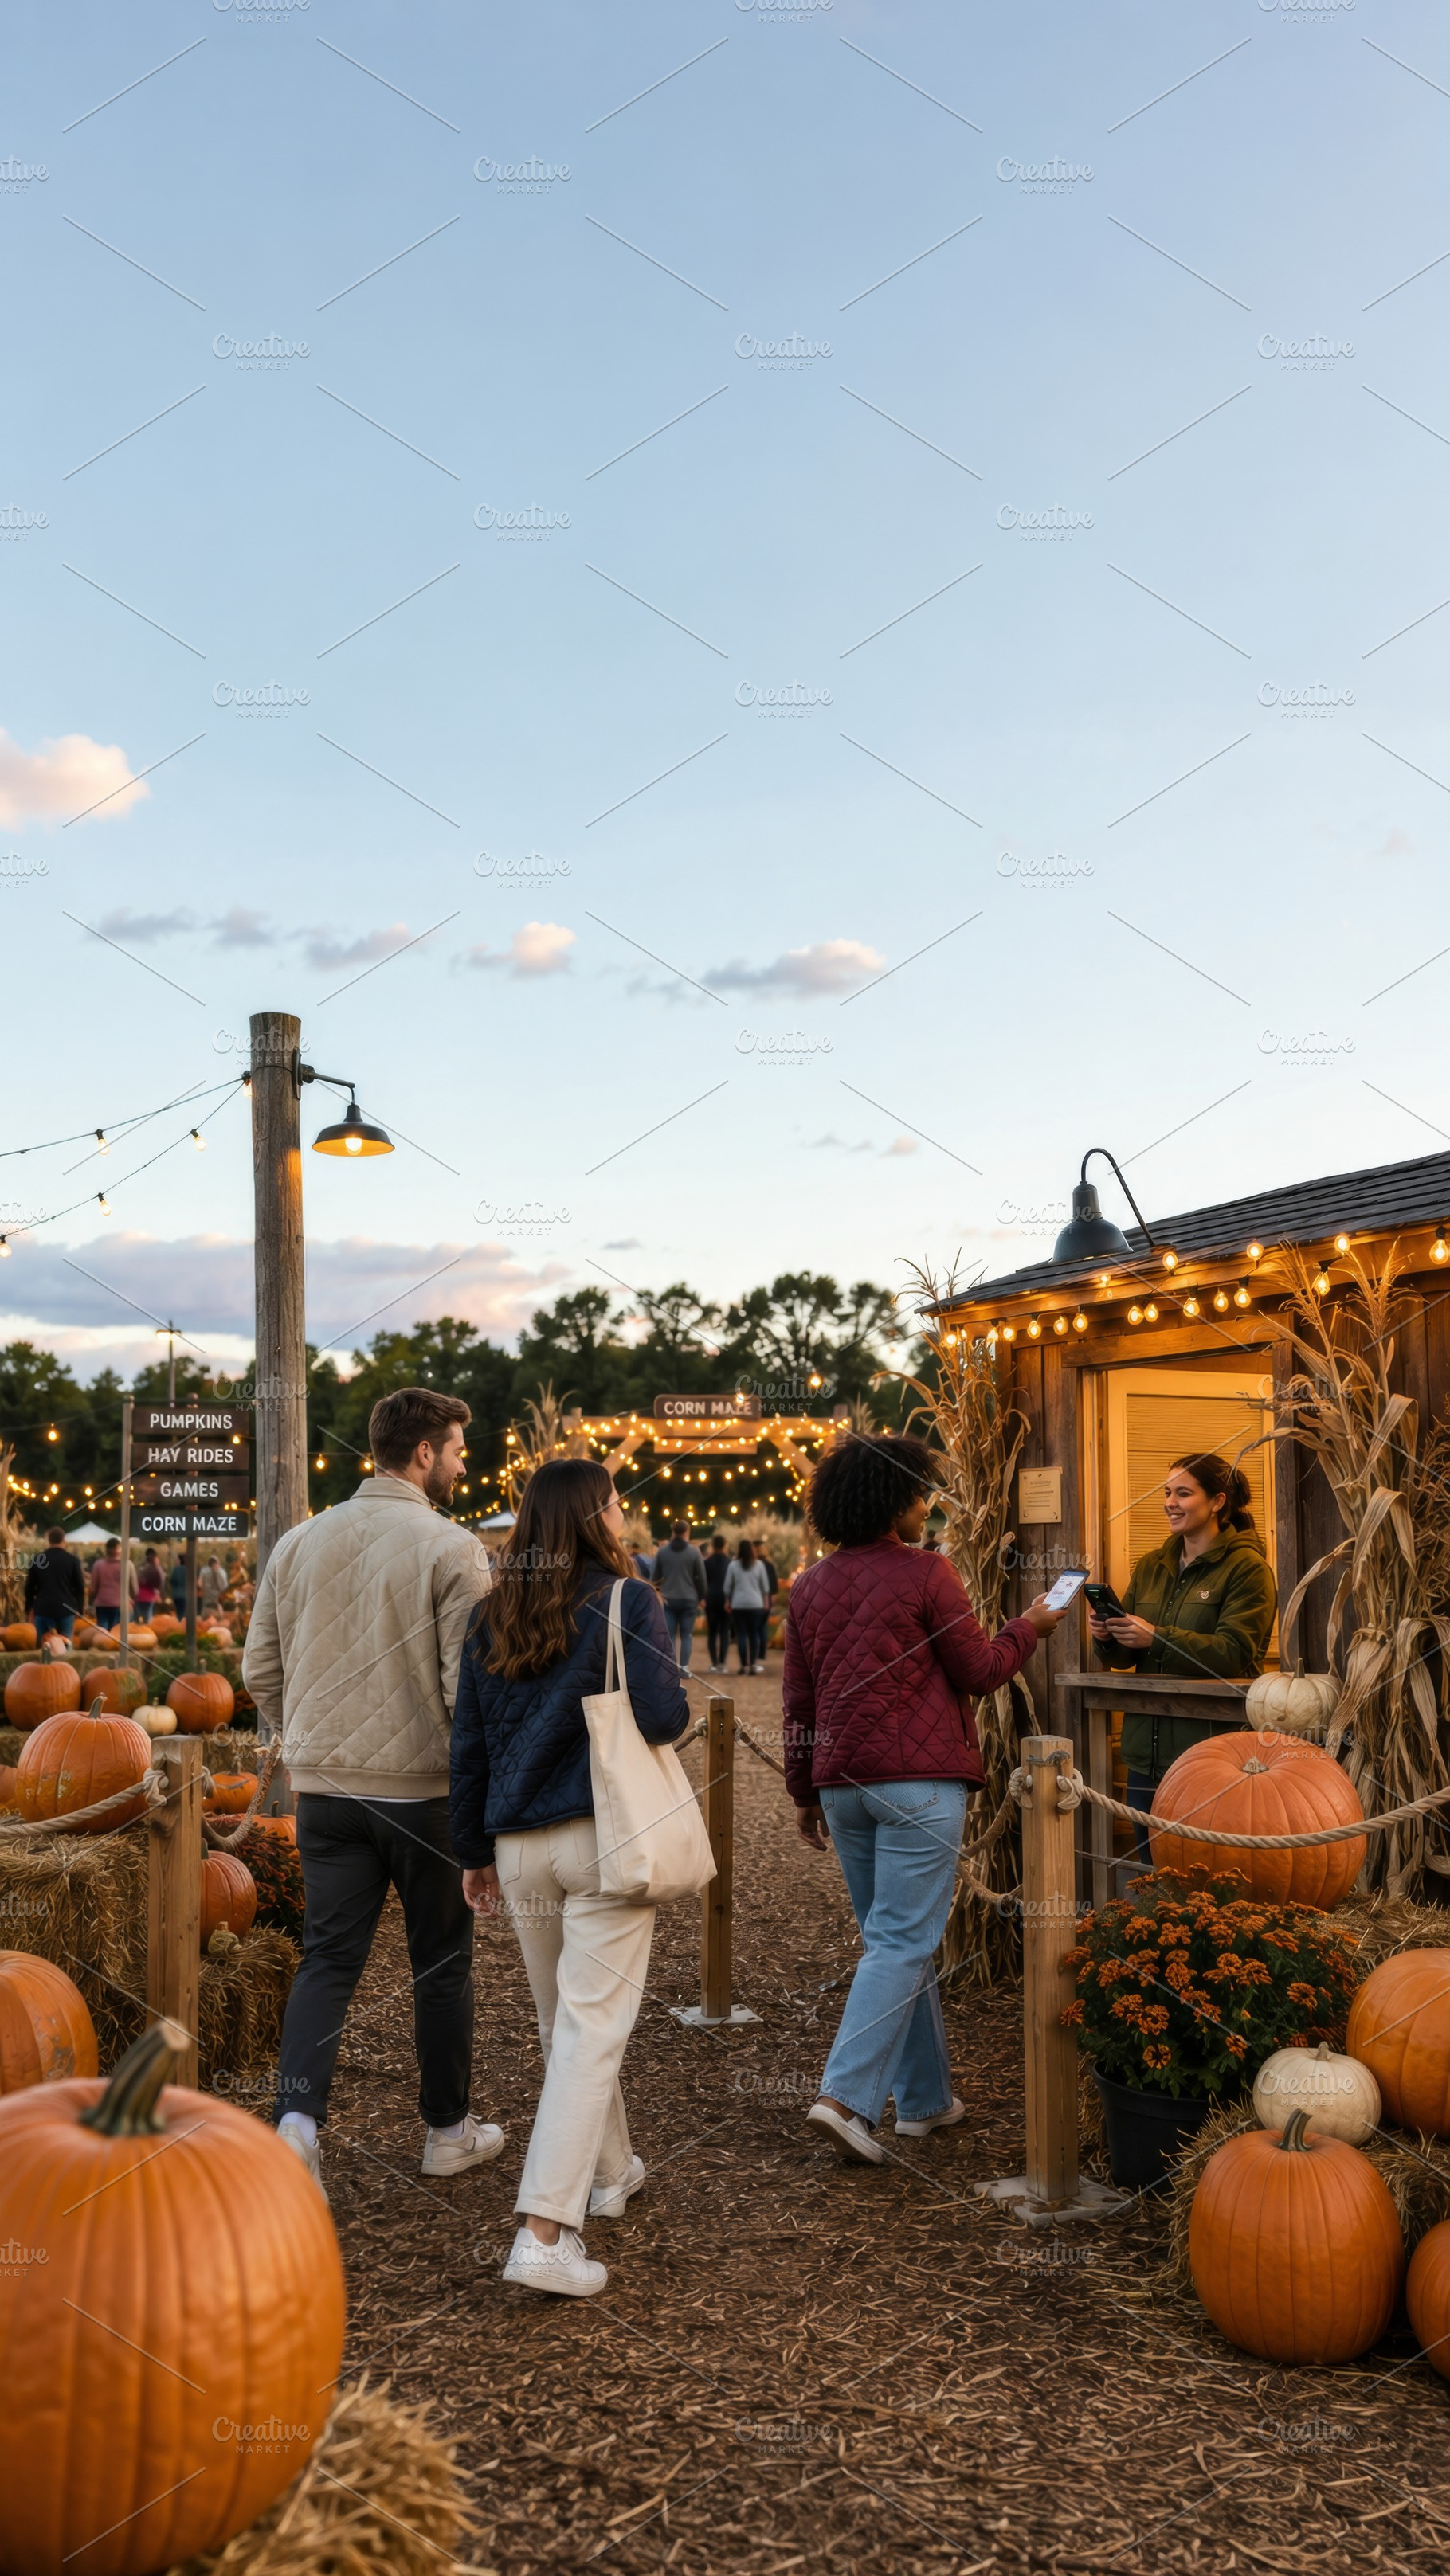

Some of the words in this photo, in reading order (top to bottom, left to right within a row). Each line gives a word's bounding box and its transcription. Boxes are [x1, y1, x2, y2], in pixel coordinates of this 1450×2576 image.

[664, 1401, 705, 1415] CORN
[150, 1413, 233, 1429] PUMPKINS
[148, 1447, 181, 1463] HAY
[187, 1448, 233, 1463] RIDES
[160, 1482, 219, 1497] GAMES
[142, 1516, 186, 1531] CORN
[193, 1516, 237, 1531] MAZE
